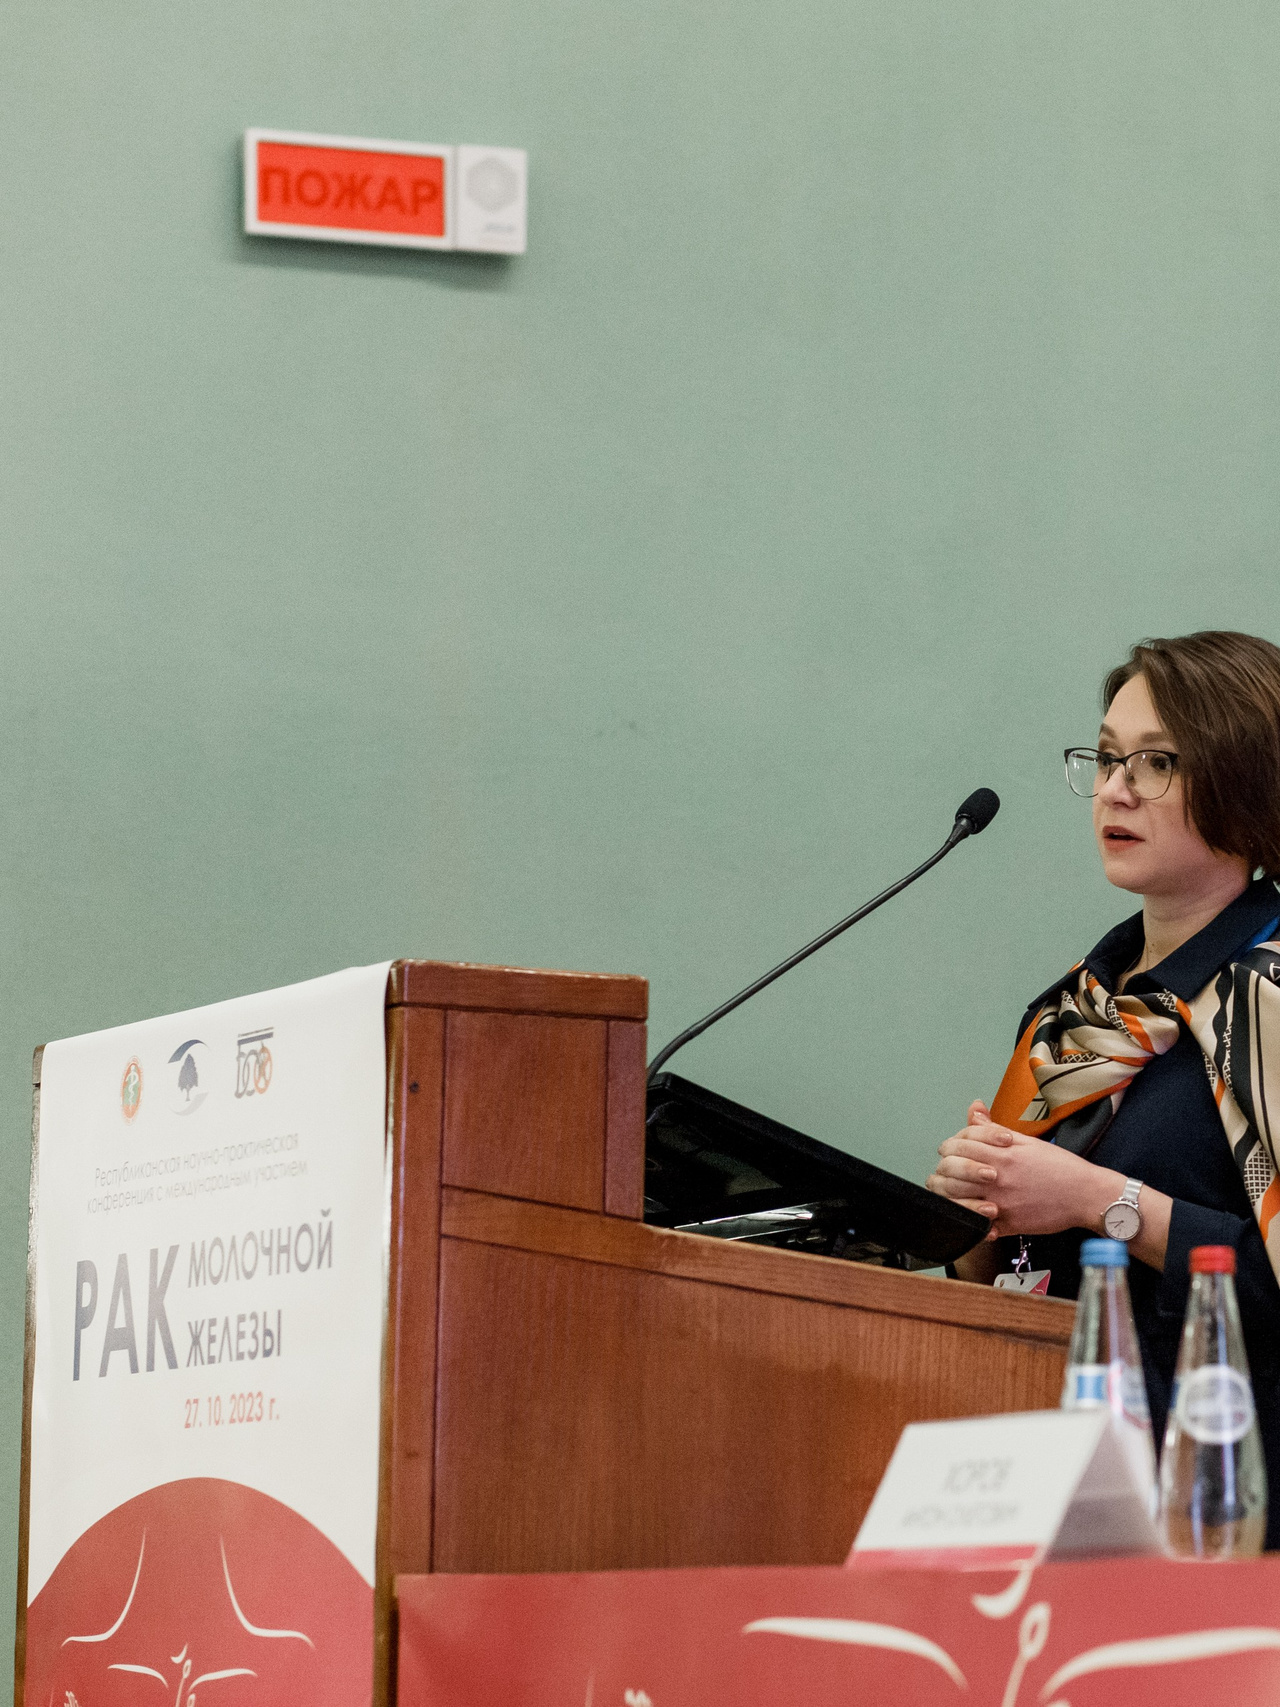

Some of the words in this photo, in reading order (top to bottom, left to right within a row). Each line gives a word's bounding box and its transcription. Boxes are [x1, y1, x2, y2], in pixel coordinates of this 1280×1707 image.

[260, 164, 440, 217] ПОЖАР
[87, 1187, 154, 1215] конференция
[156, 1186, 163, 1201] с
[165, 1169, 252, 1200] международным
[253, 1159, 308, 1188] участием
[94, 1160, 181, 1188] Республиканская
[183, 1132, 299, 1173] научно-практическая
[187, 1207, 333, 1288] МОЛОЧНОЙ
[73, 1244, 180, 1381] РАК
[186, 1309, 282, 1368] ЖЕЛЕЗЫ
[229, 1391, 264, 1424] 2023
